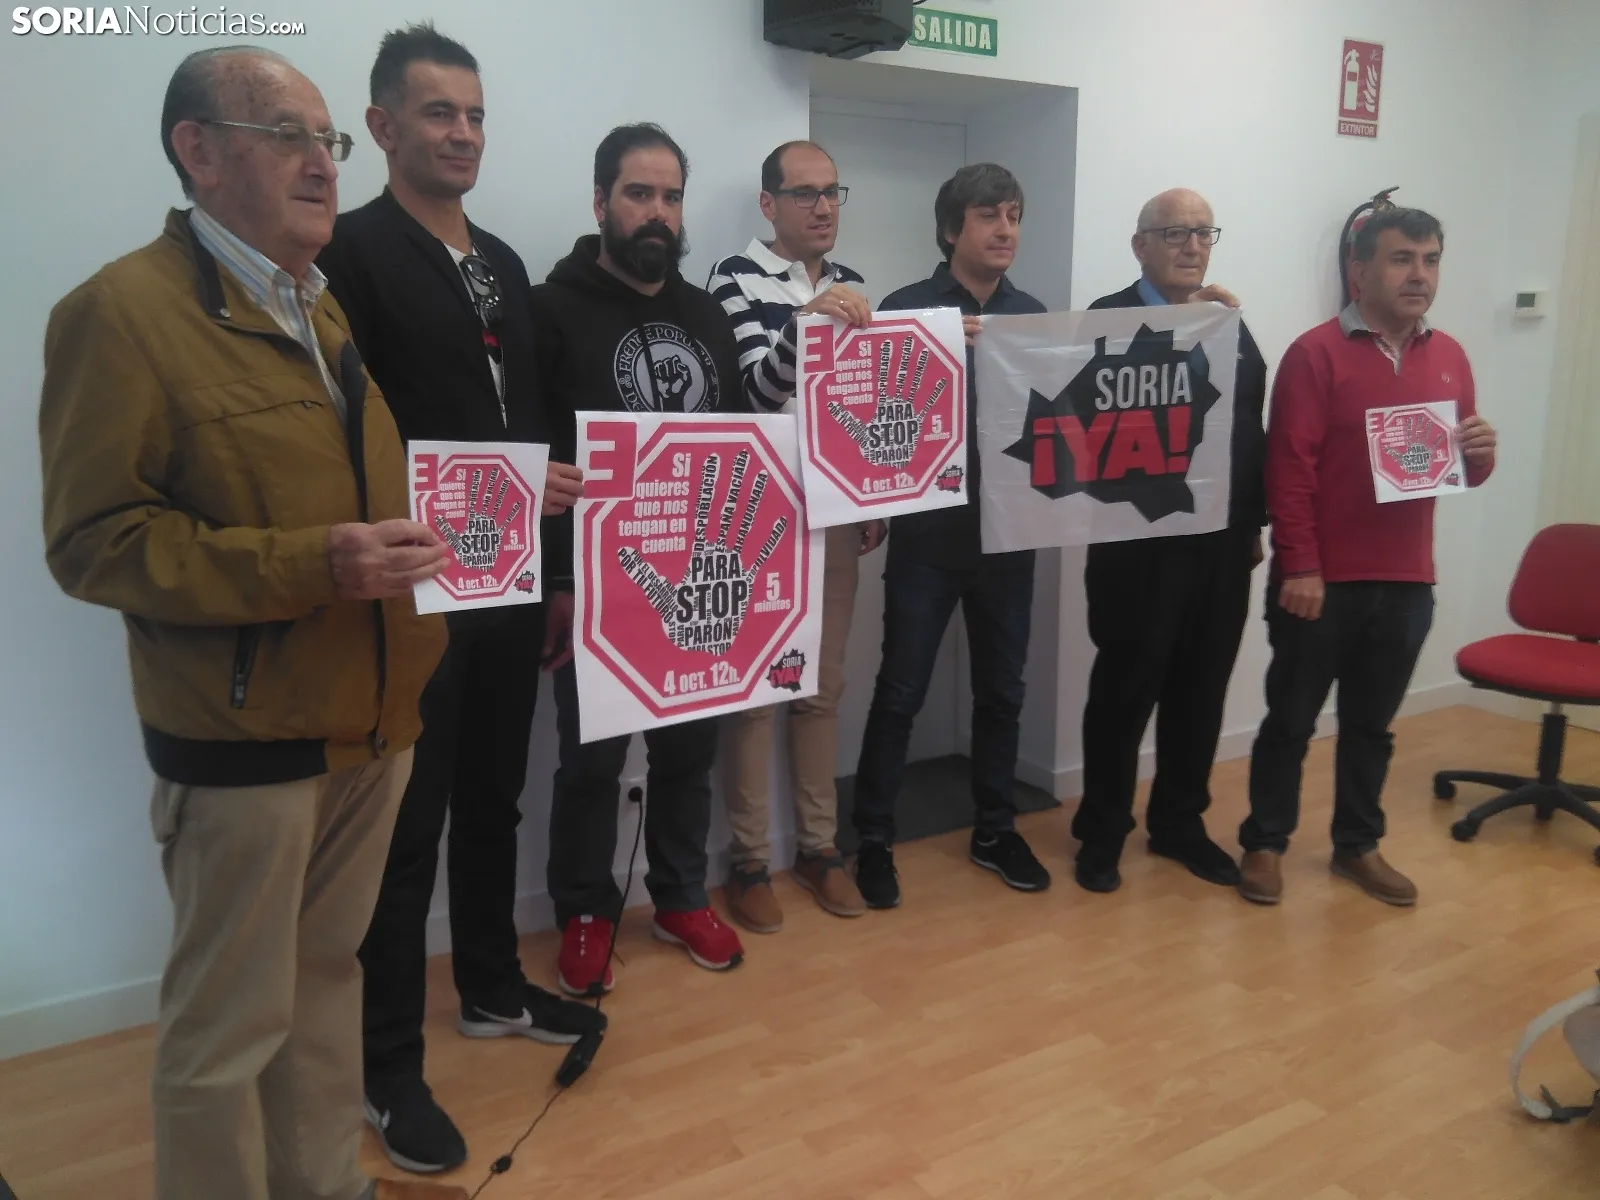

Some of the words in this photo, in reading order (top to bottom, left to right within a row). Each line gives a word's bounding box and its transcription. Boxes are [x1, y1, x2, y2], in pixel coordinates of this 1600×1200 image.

[914, 14, 991, 50] SALIDA
[1340, 122, 1375, 136] EXTINTOR
[858, 341, 872, 357] Si
[836, 359, 872, 371] quieres
[835, 372, 854, 383] que
[855, 371, 872, 381] nos
[1095, 362, 1192, 410] SORIA
[826, 383, 860, 395] tengan
[860, 382, 873, 392] en
[843, 394, 873, 405] cuenta
[878, 403, 913, 423] PARA
[932, 415, 942, 433] 5
[868, 420, 918, 448] STOP
[1032, 406, 1191, 486] ¡YA!
[672, 452, 691, 478] Si
[727, 450, 749, 504] VACIADA
[862, 477, 871, 493] 4
[636, 479, 690, 498] quieres
[634, 501, 661, 518] que
[663, 500, 688, 515] nos
[469, 519, 496, 534] PARA
[618, 519, 667, 537] tengan
[669, 518, 687, 533] en
[461, 534, 499, 554] STOP
[509, 530, 518, 545] 5
[641, 536, 686, 554] cuenta
[692, 554, 741, 583] PARA
[458, 577, 464, 590] 4
[618, 548, 636, 575] POR
[632, 568, 649, 587] TU
[643, 582, 674, 623] FUTURO
[766, 572, 780, 601] 5
[676, 580, 748, 623] STOP
[754, 599, 791, 613] minutos
[685, 618, 732, 647] PARÓN
[663, 670, 676, 695] 4
[680, 671, 707, 692] OCT.
[710, 661, 740, 687] 12h.
